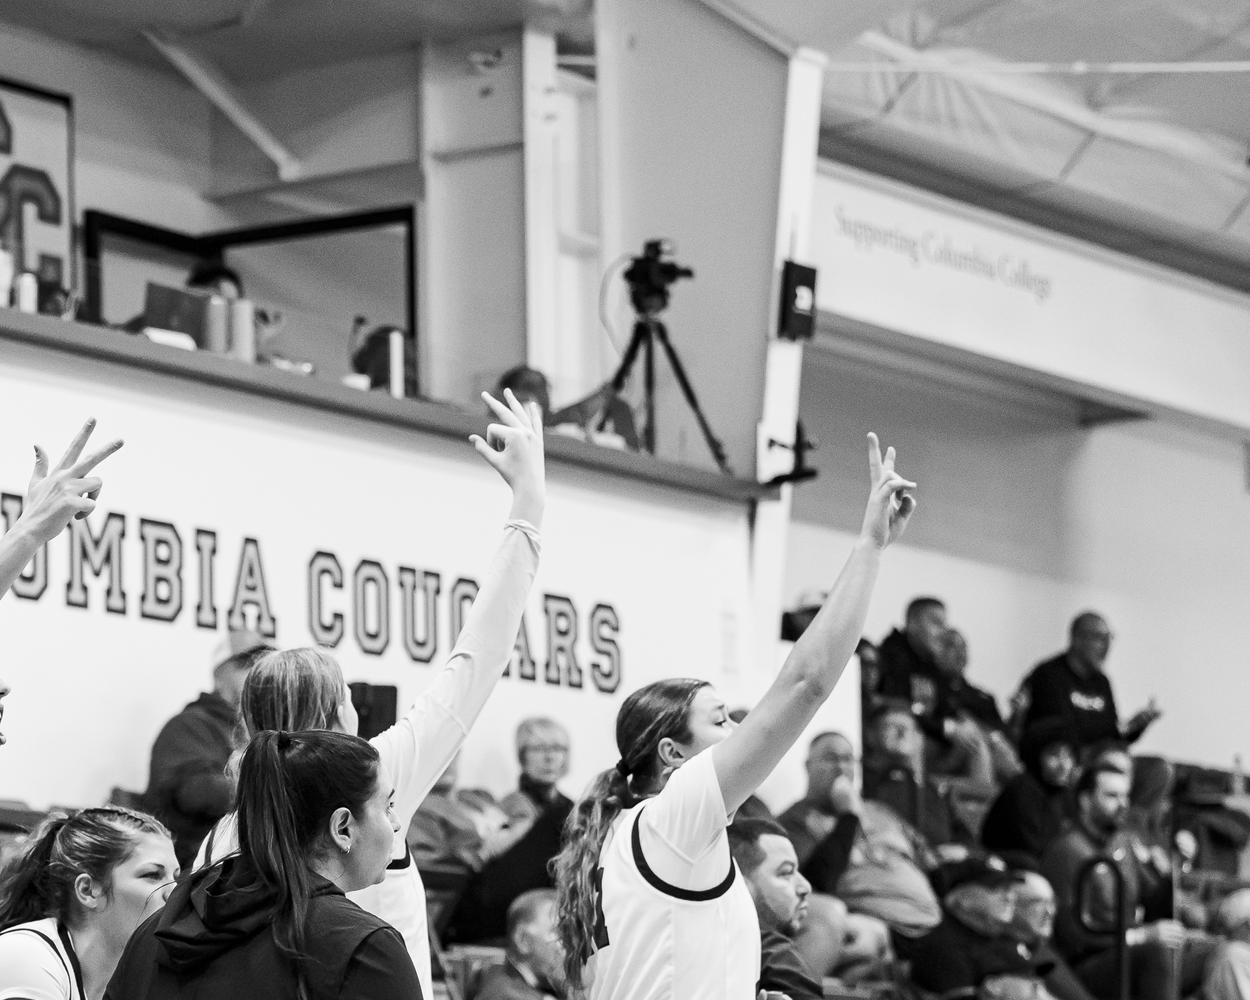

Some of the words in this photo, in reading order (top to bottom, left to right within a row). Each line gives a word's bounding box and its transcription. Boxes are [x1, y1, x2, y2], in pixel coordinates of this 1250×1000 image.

[834, 203, 919, 269] Supporting
[920, 229, 996, 281] Columbia
[997, 253, 1051, 304] College
